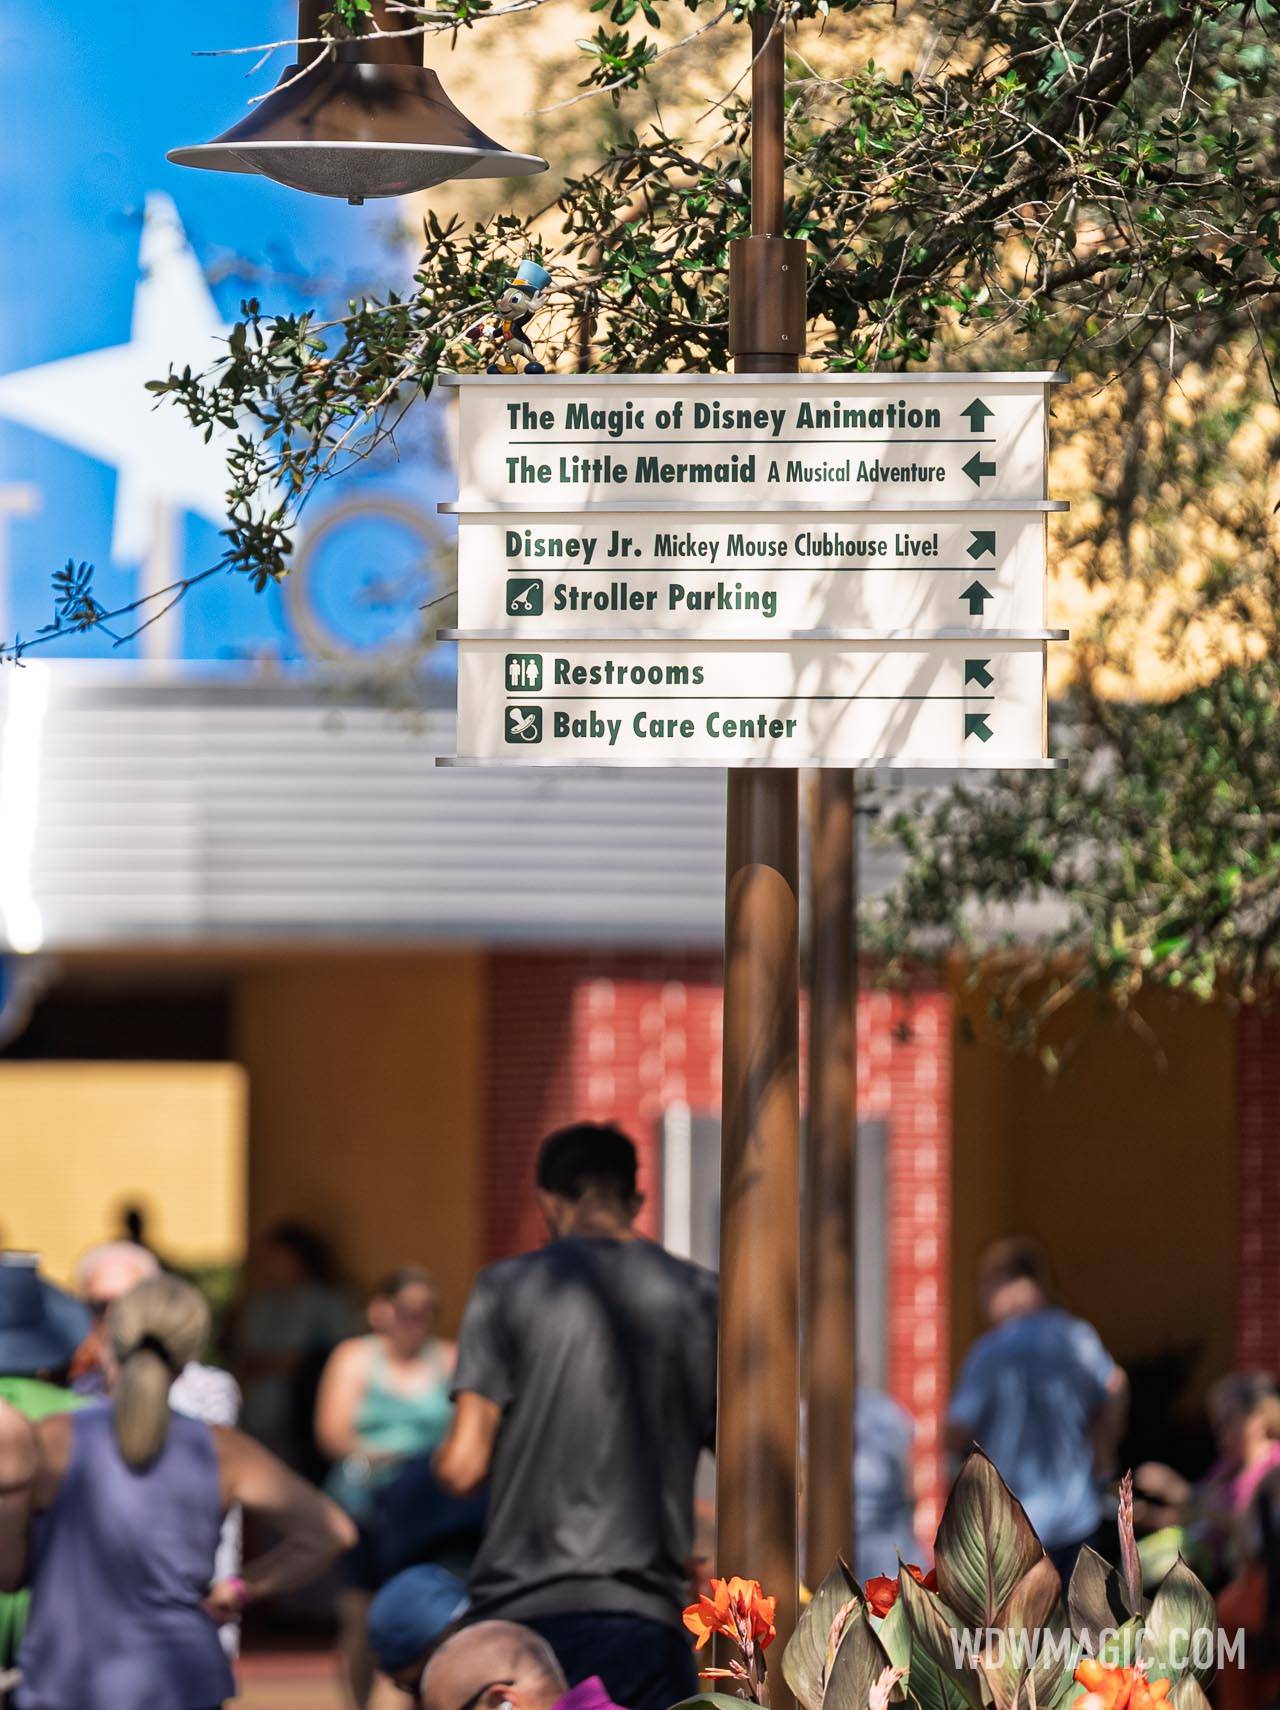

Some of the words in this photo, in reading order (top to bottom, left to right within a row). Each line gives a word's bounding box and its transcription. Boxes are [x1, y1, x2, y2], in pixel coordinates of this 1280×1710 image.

[506, 401, 555, 430] The
[565, 401, 645, 438] Magic
[655, 401, 683, 430] of
[694, 401, 787, 437] Disney
[795, 400, 941, 429] Animation
[505, 455, 552, 484] The
[559, 455, 628, 484] Little
[634, 454, 756, 484] Mermaid
[767, 460, 781, 483] A
[786, 459, 850, 483] Musical
[856, 459, 946, 483] Adventure
[506, 529, 598, 563] Disney
[607, 530, 642, 558] Jr.
[653, 532, 720, 563] Mickey
[726, 534, 788, 557] Mouse
[794, 532, 888, 557] Clubhouse
[895, 533, 939, 557] Live!
[554, 582, 658, 611] Stroller
[669, 582, 777, 618] Parking
[554, 658, 704, 685] Restrooms
[553, 710, 622, 746] Baby
[633, 711, 695, 738] Care
[706, 711, 797, 739] Center
